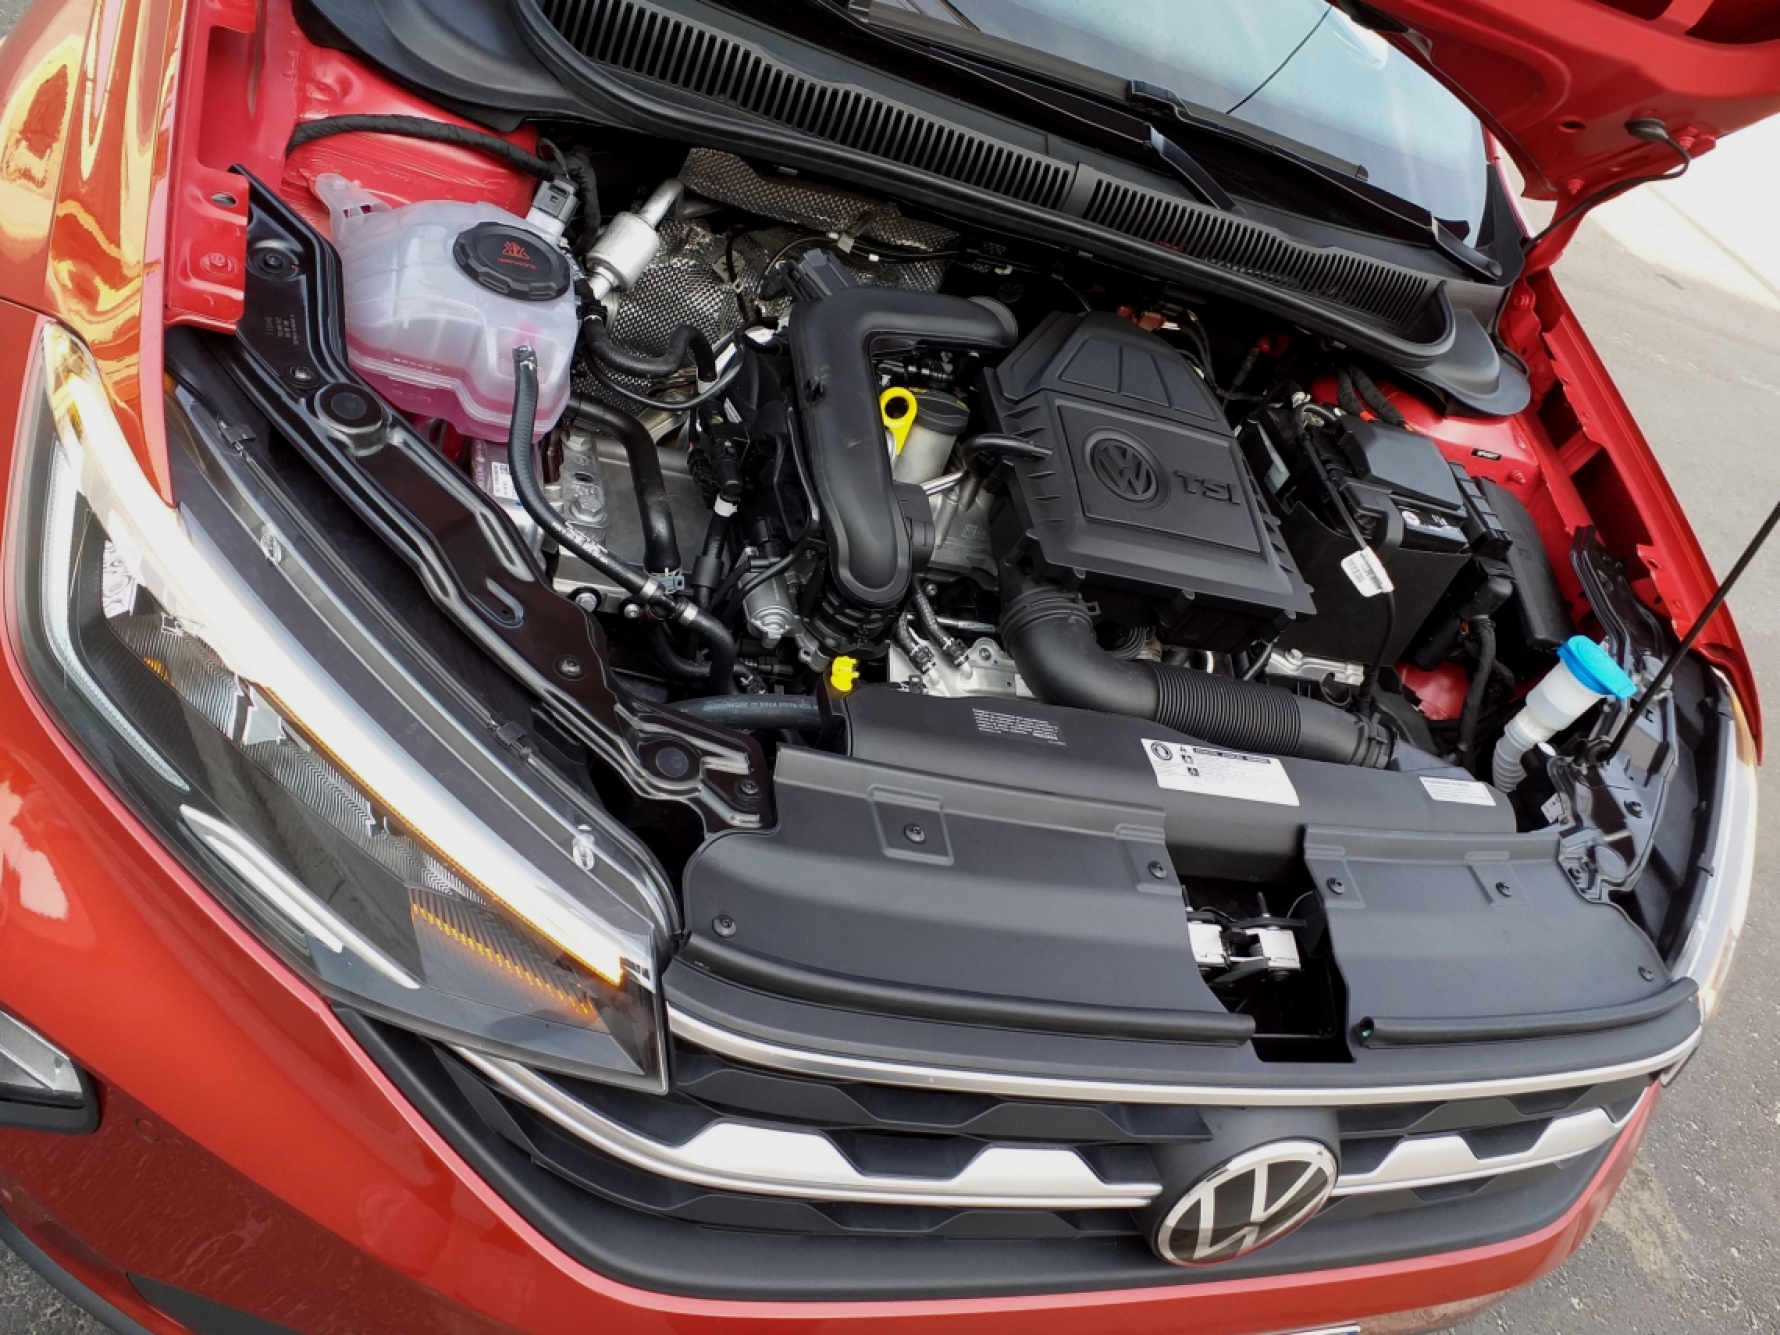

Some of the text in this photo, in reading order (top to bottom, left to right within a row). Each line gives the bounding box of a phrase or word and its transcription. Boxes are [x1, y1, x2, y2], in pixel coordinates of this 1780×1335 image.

[1091, 437, 1160, 502] VW
[1173, 469, 1241, 506] TSI
[1157, 1143, 1335, 1266] VW
